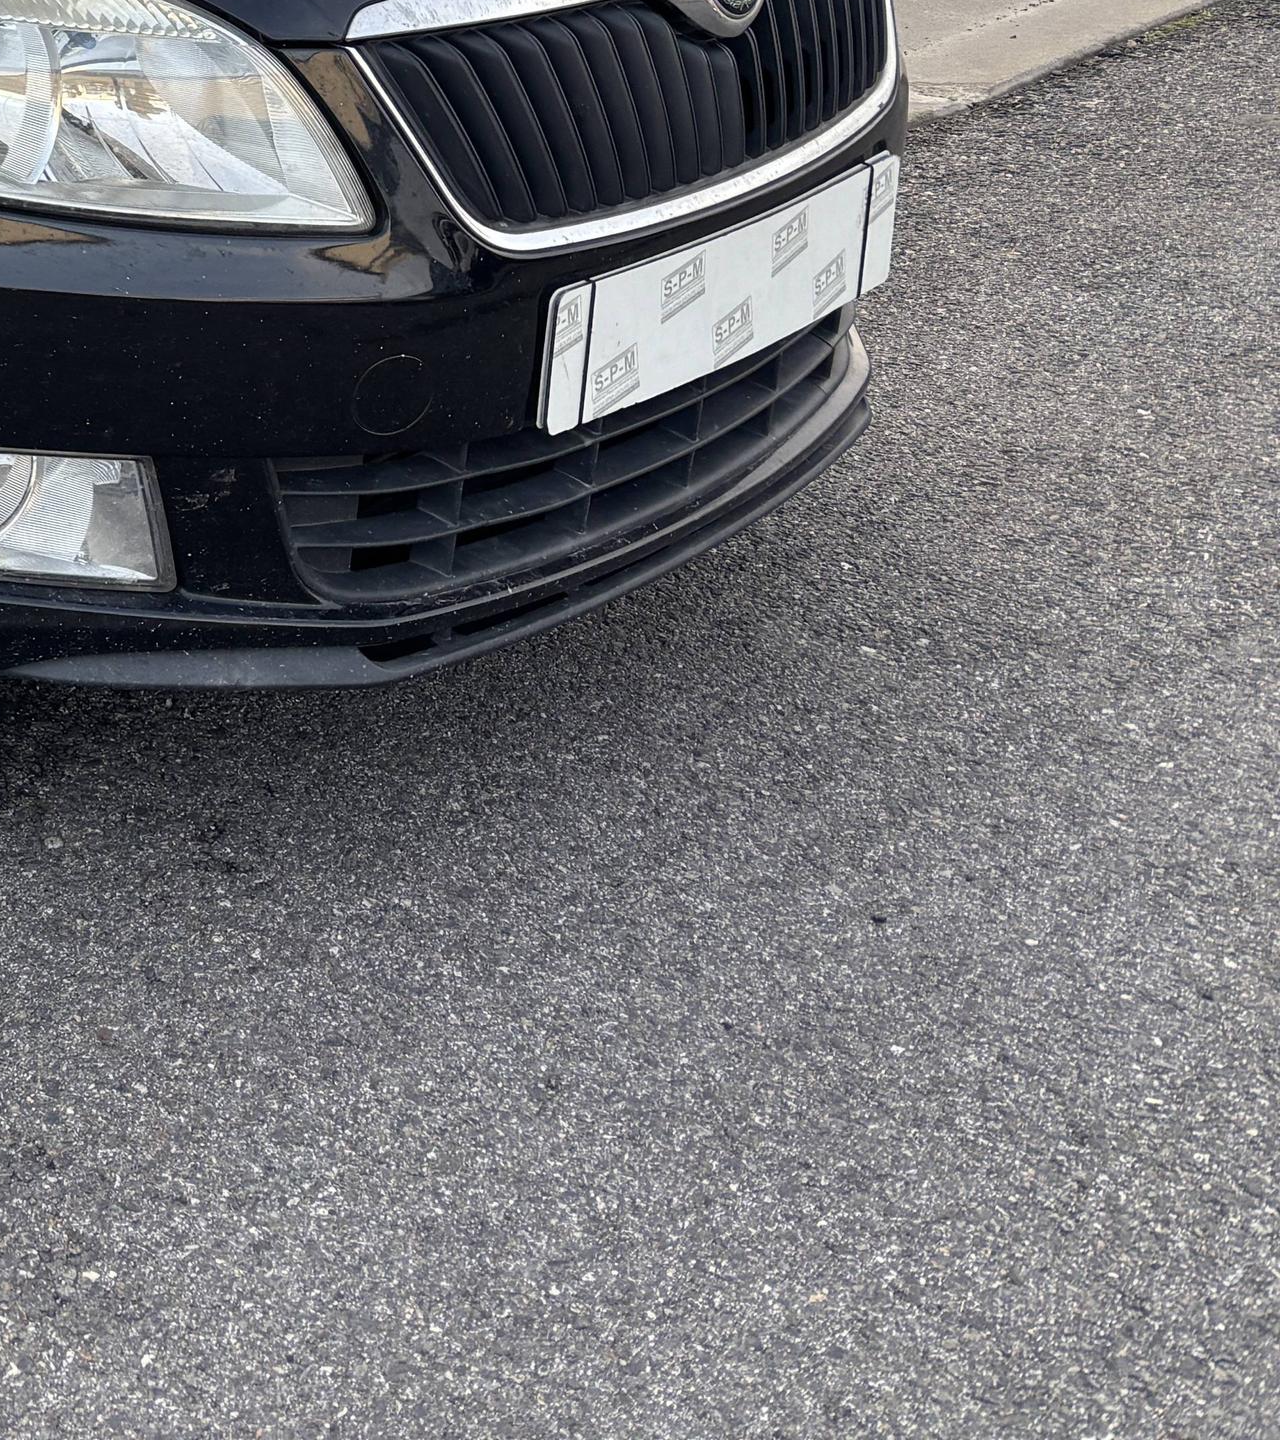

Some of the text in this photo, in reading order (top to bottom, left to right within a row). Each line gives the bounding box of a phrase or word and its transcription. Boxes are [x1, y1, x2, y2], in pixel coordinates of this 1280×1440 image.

[774, 211, 807, 252] S-P-M
[664, 258, 704, 298] S-P-M
[815, 257, 844, 297] S-P-M
[715, 303, 750, 344] S-P-M
[594, 351, 636, 392] S-P-M
